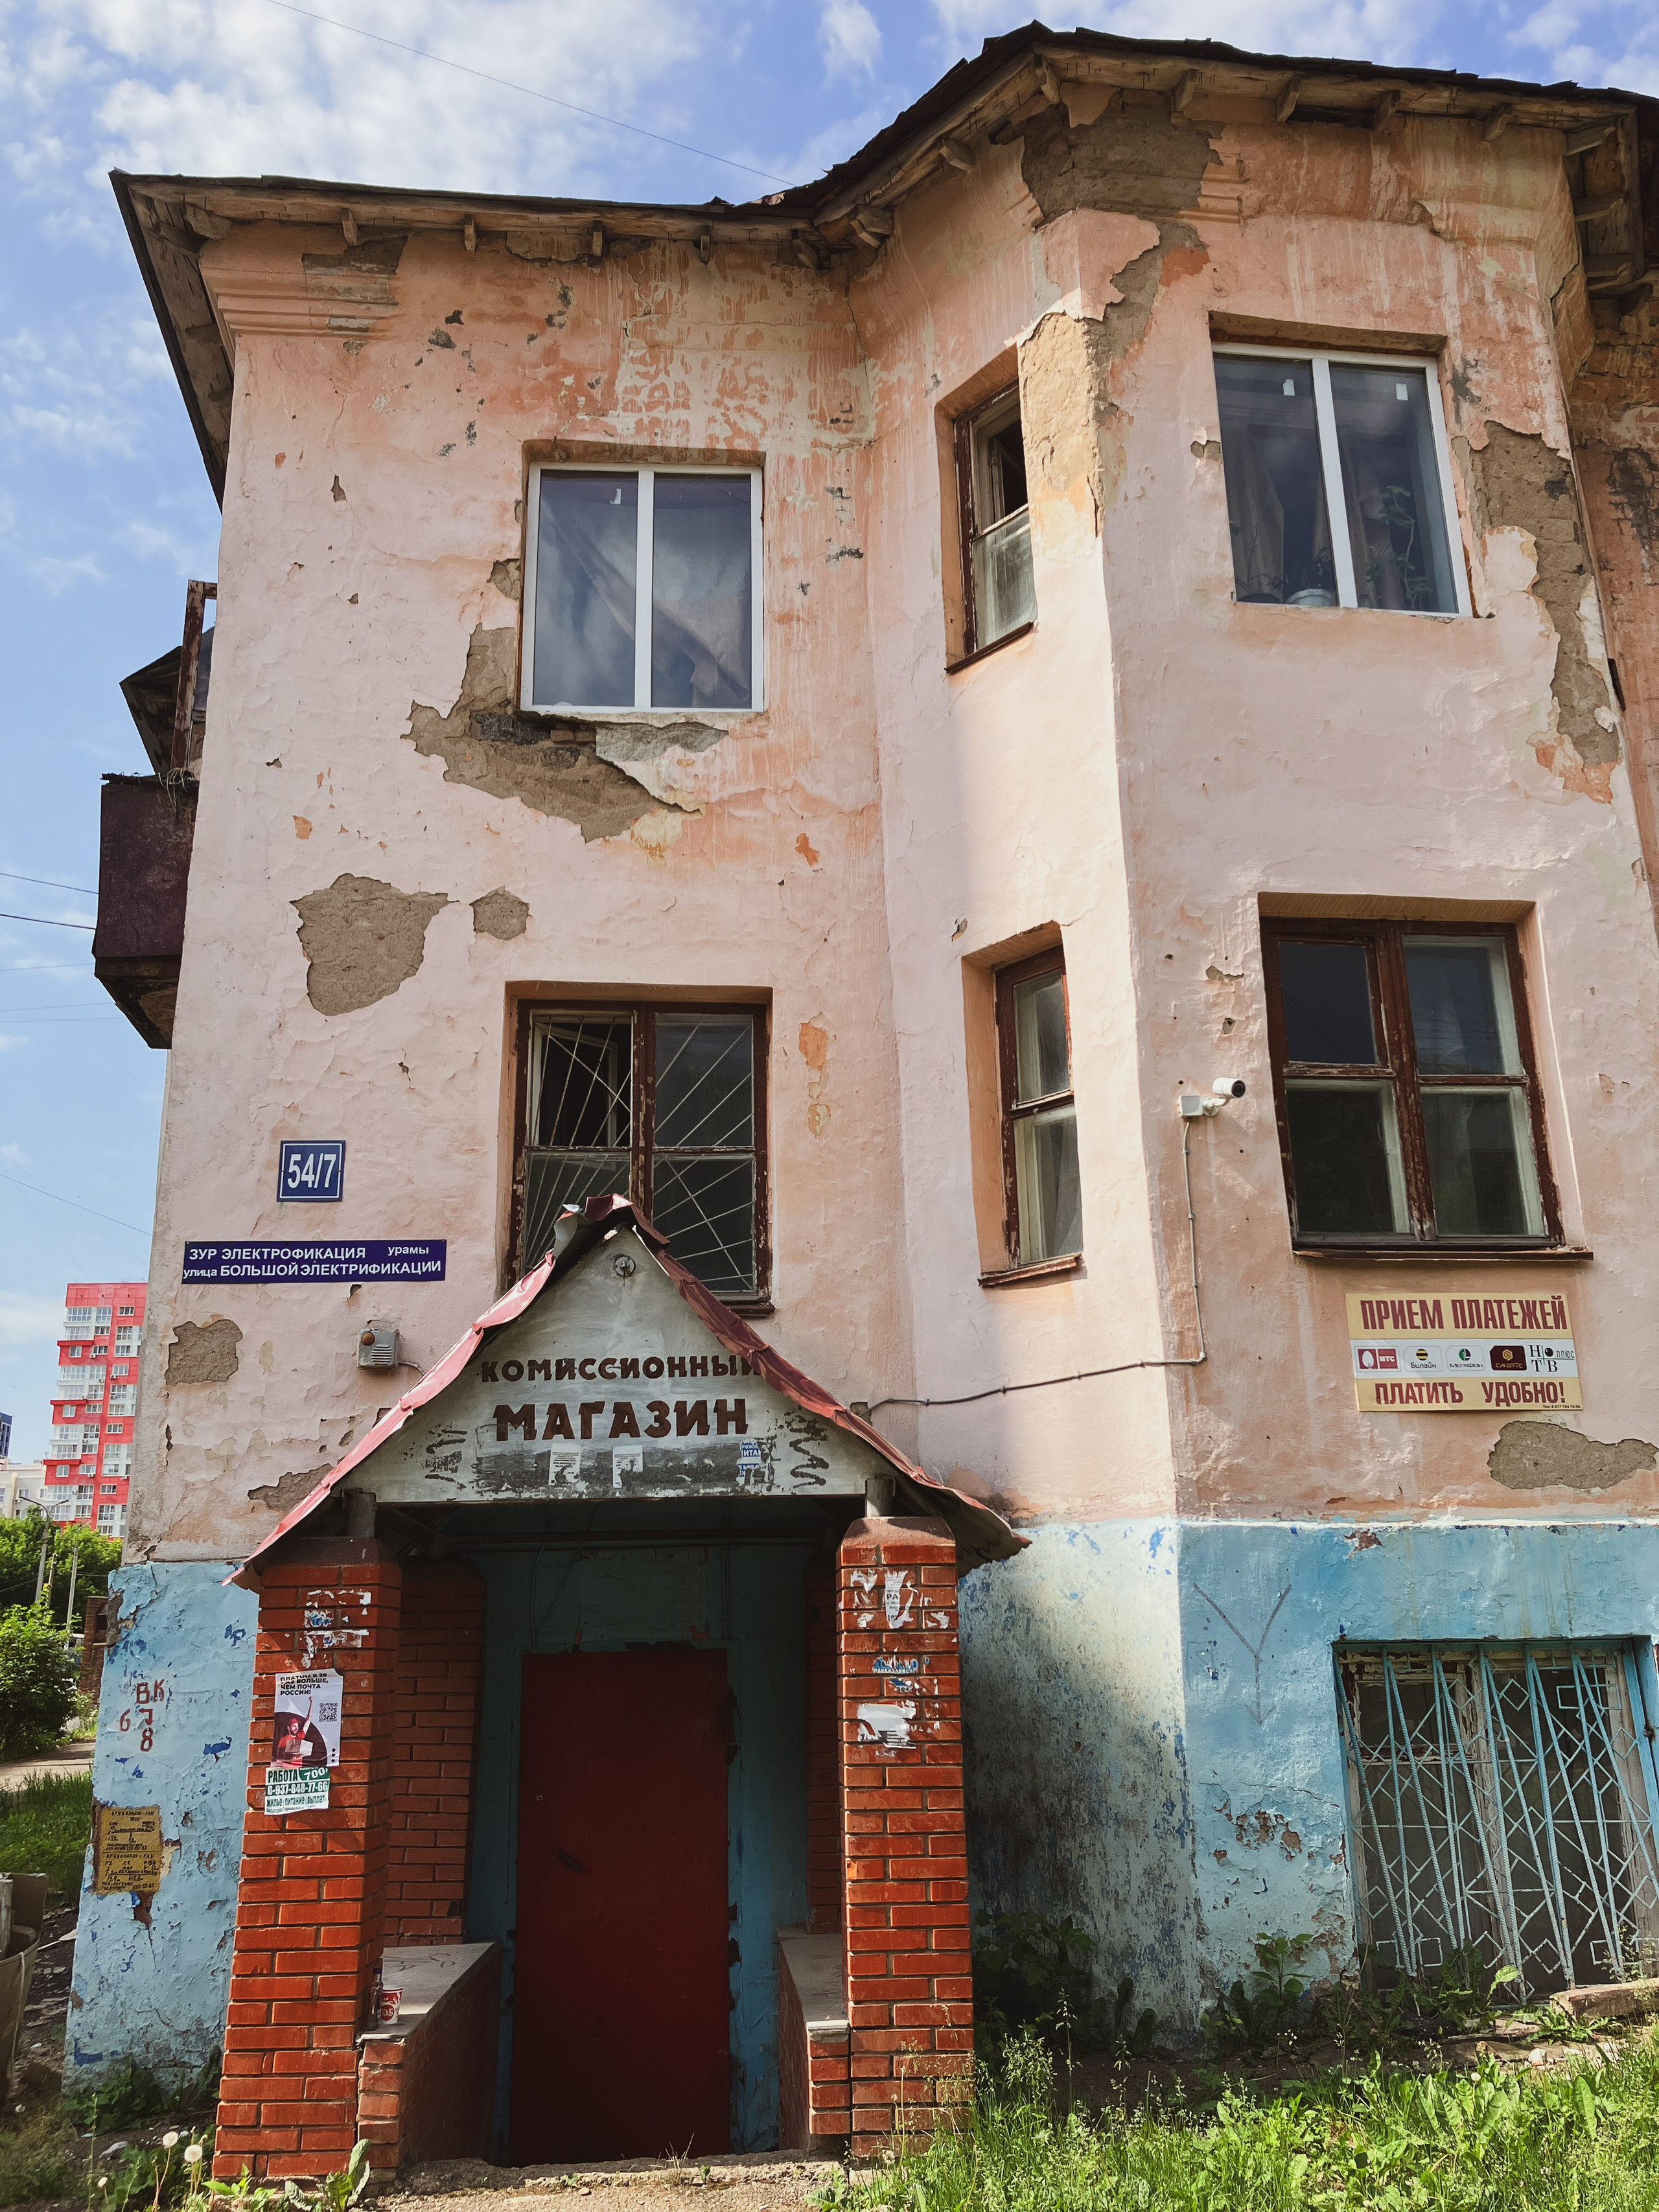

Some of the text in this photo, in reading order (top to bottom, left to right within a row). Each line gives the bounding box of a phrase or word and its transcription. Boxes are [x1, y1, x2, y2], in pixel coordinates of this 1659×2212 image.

[287, 1152, 337, 1189] 54/7
[189, 1246, 429, 1261] ЗУР ЭЛЕКТРОФИКАЦИЯ урамы
[183, 1260, 441, 1279] улица БОЛЬШОЙ ЭЛЕКТРИФИКАЦИИ
[1360, 1295, 1568, 1330] ПРИЕМ ПЛАТЕЖЕЙ
[1375, 1381, 1566, 1407] ПЛАТИТЬ УДОБНО!
[493, 1398, 749, 1441] МАГАЗИН
[120, 1708, 131, 1732] 6
[140, 1727, 154, 1752] 8
[267, 1781, 328, 1795] 8-937-848-77-66
[268, 1769, 298, 1783] РАБОТА
[266, 1798, 283, 1807] жилье
[285, 1797, 305, 1806] питание
